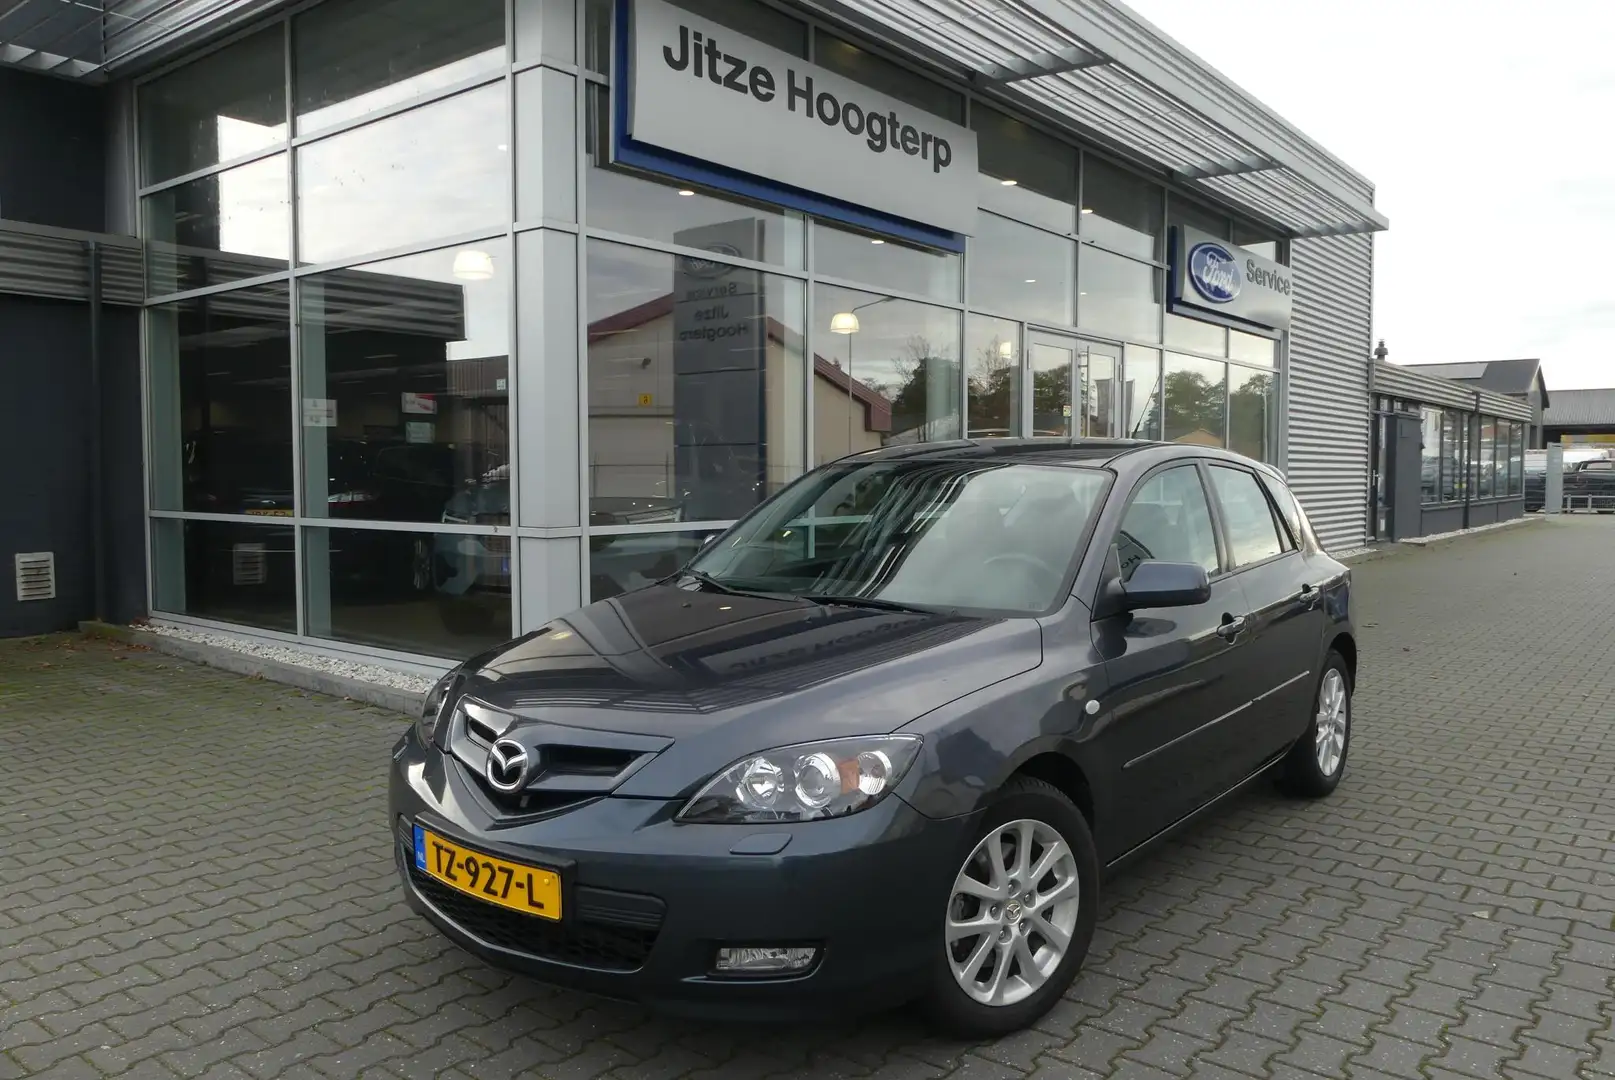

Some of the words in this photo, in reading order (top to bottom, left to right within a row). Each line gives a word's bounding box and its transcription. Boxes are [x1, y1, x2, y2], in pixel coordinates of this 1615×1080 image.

[662, 24, 776, 103] Jitze
[787, 68, 952, 173] Hoogterp
[1246, 258, 1291, 296] Service
[432, 841, 545, 909] TZ-927-L
